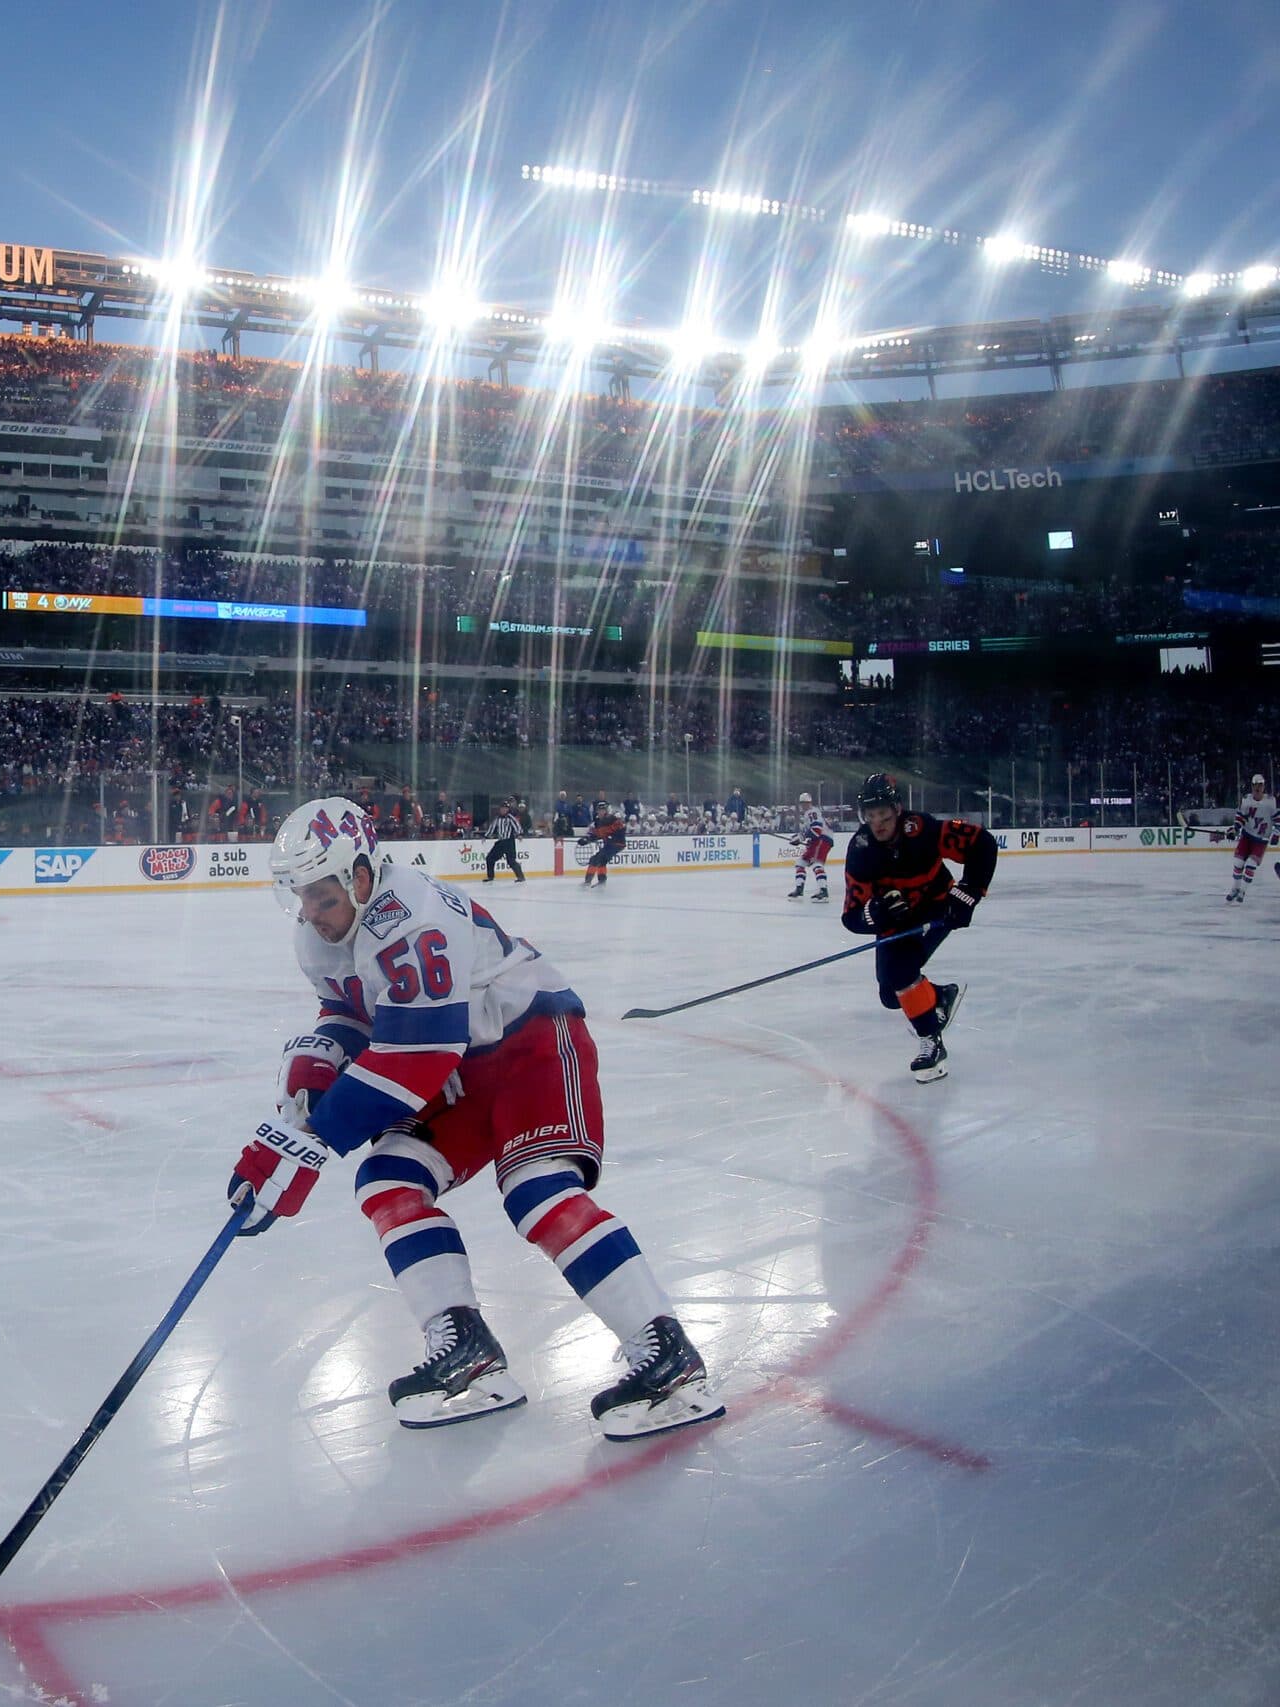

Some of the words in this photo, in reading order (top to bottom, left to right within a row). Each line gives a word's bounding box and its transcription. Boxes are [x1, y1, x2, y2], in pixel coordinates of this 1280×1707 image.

[31, 425, 69, 436] HESS
[954, 467, 1062, 493] HCLTech
[38, 595, 49, 608] 4
[232, 606, 287, 618] RANGERS
[510, 623, 545, 633] STADIUM
[692, 838, 713, 849] THIS
[716, 837, 726, 848] IS
[1021, 831, 1040, 849] CAT
[1157, 828, 1195, 846] NFP
[147, 849, 188, 863] Jersey
[212, 851, 220, 862] a
[224, 848, 247, 862] sub
[609, 854, 629, 864] EDIT
[631, 853, 661, 863] UNION
[677, 851, 700, 862] NEW
[703, 850, 740, 861] JERSEY.
[35, 854, 83, 878] SAP
[209, 864, 250, 877] above
[376, 928, 454, 1004] 56
[284, 1036, 335, 1053] UER
